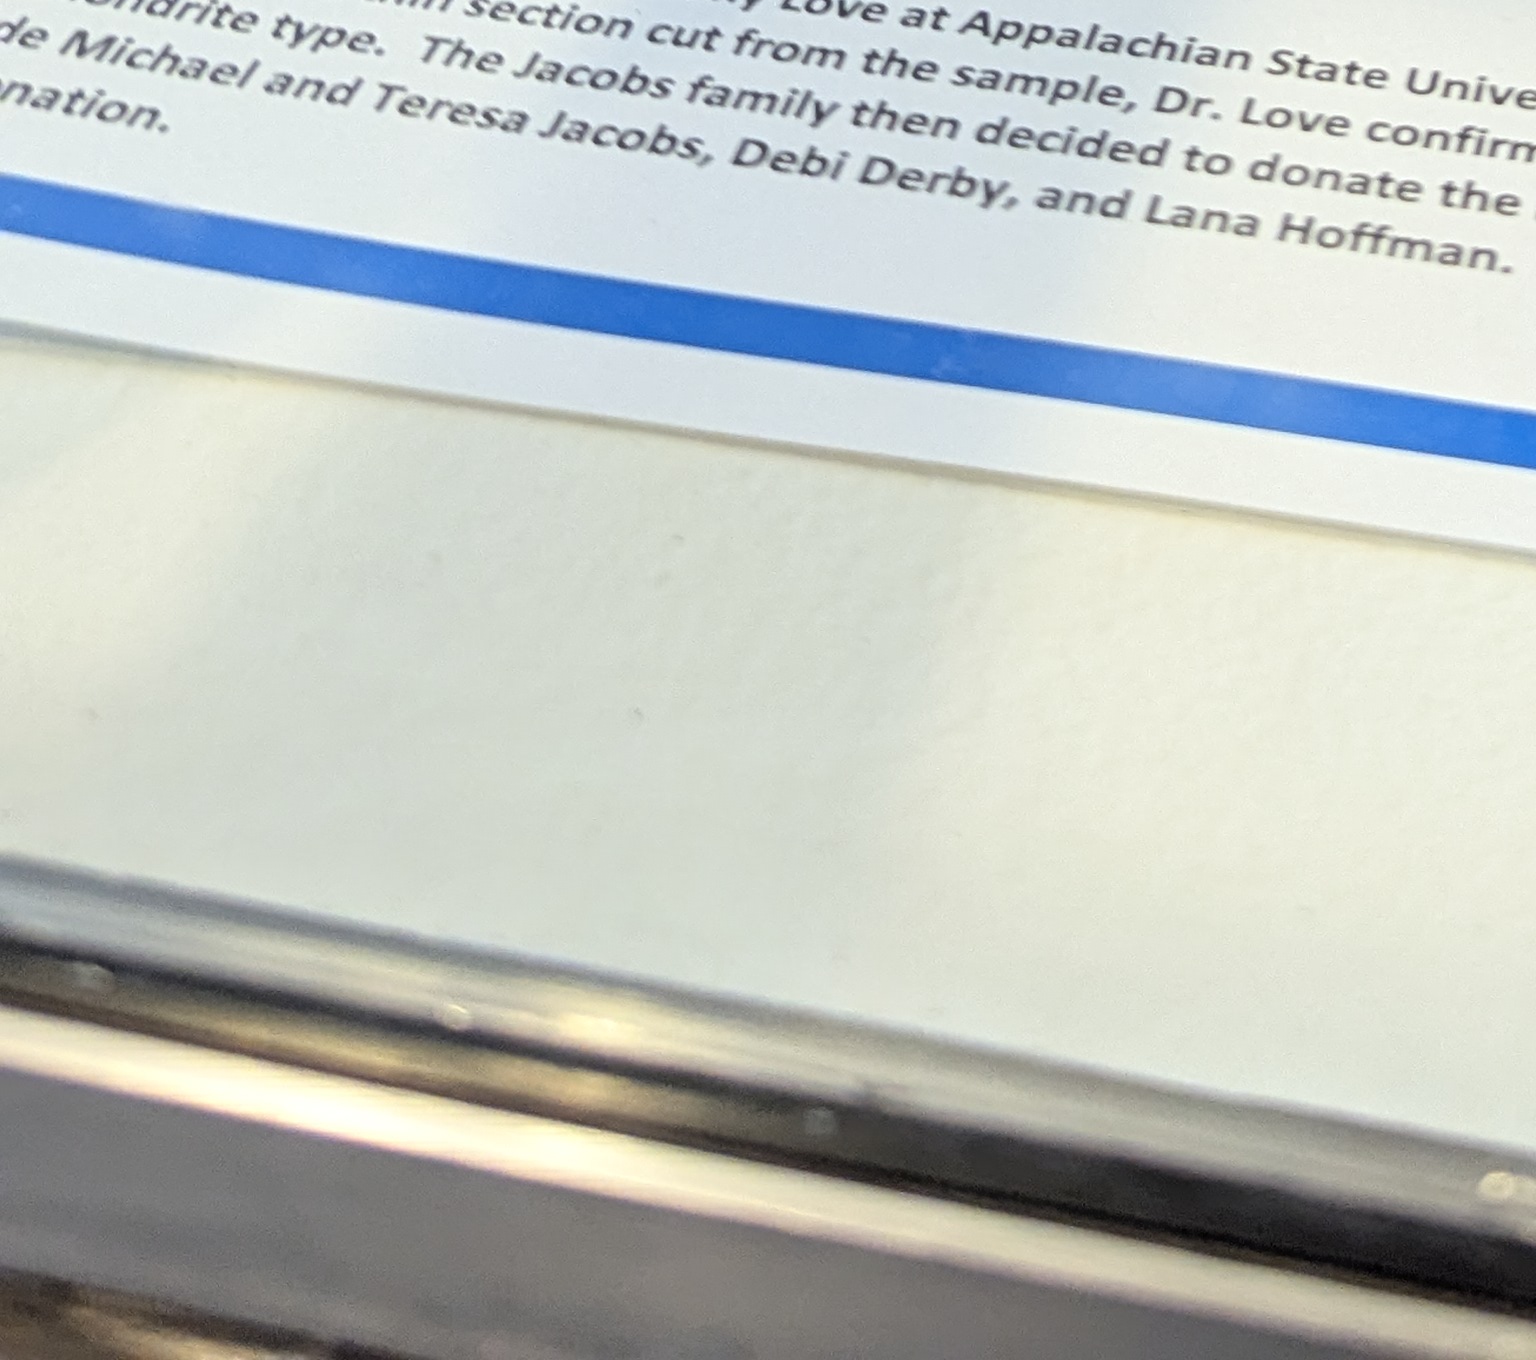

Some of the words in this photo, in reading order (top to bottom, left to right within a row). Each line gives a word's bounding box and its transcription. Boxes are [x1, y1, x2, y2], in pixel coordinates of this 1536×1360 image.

[270, 13, 384, 56] type.
[512, 51, 675, 99] Jacobs
[684, 73, 841, 129] family
[849, 99, 961, 140] then
[973, 115, 1171, 167] decided
[1247, 153, 1423, 203] donate
[731, 27, 848, 70] from
[949, 64, 1136, 114] sample,
[1238, 96, 1351, 137] Love
[955, 9, 1252, 71] Appalachian
[1264, 48, 1389, 90] State
[58, 28, 261, 89] Michael
[374, 82, 530, 134] Teresa
[536, 109, 714, 167] Jacobs,
[729, 137, 850, 181] Debi
[856, 154, 1019, 209] Derby,
[1143, 193, 1260, 237] Lana
[1276, 212, 1511, 274] Hoffman.
